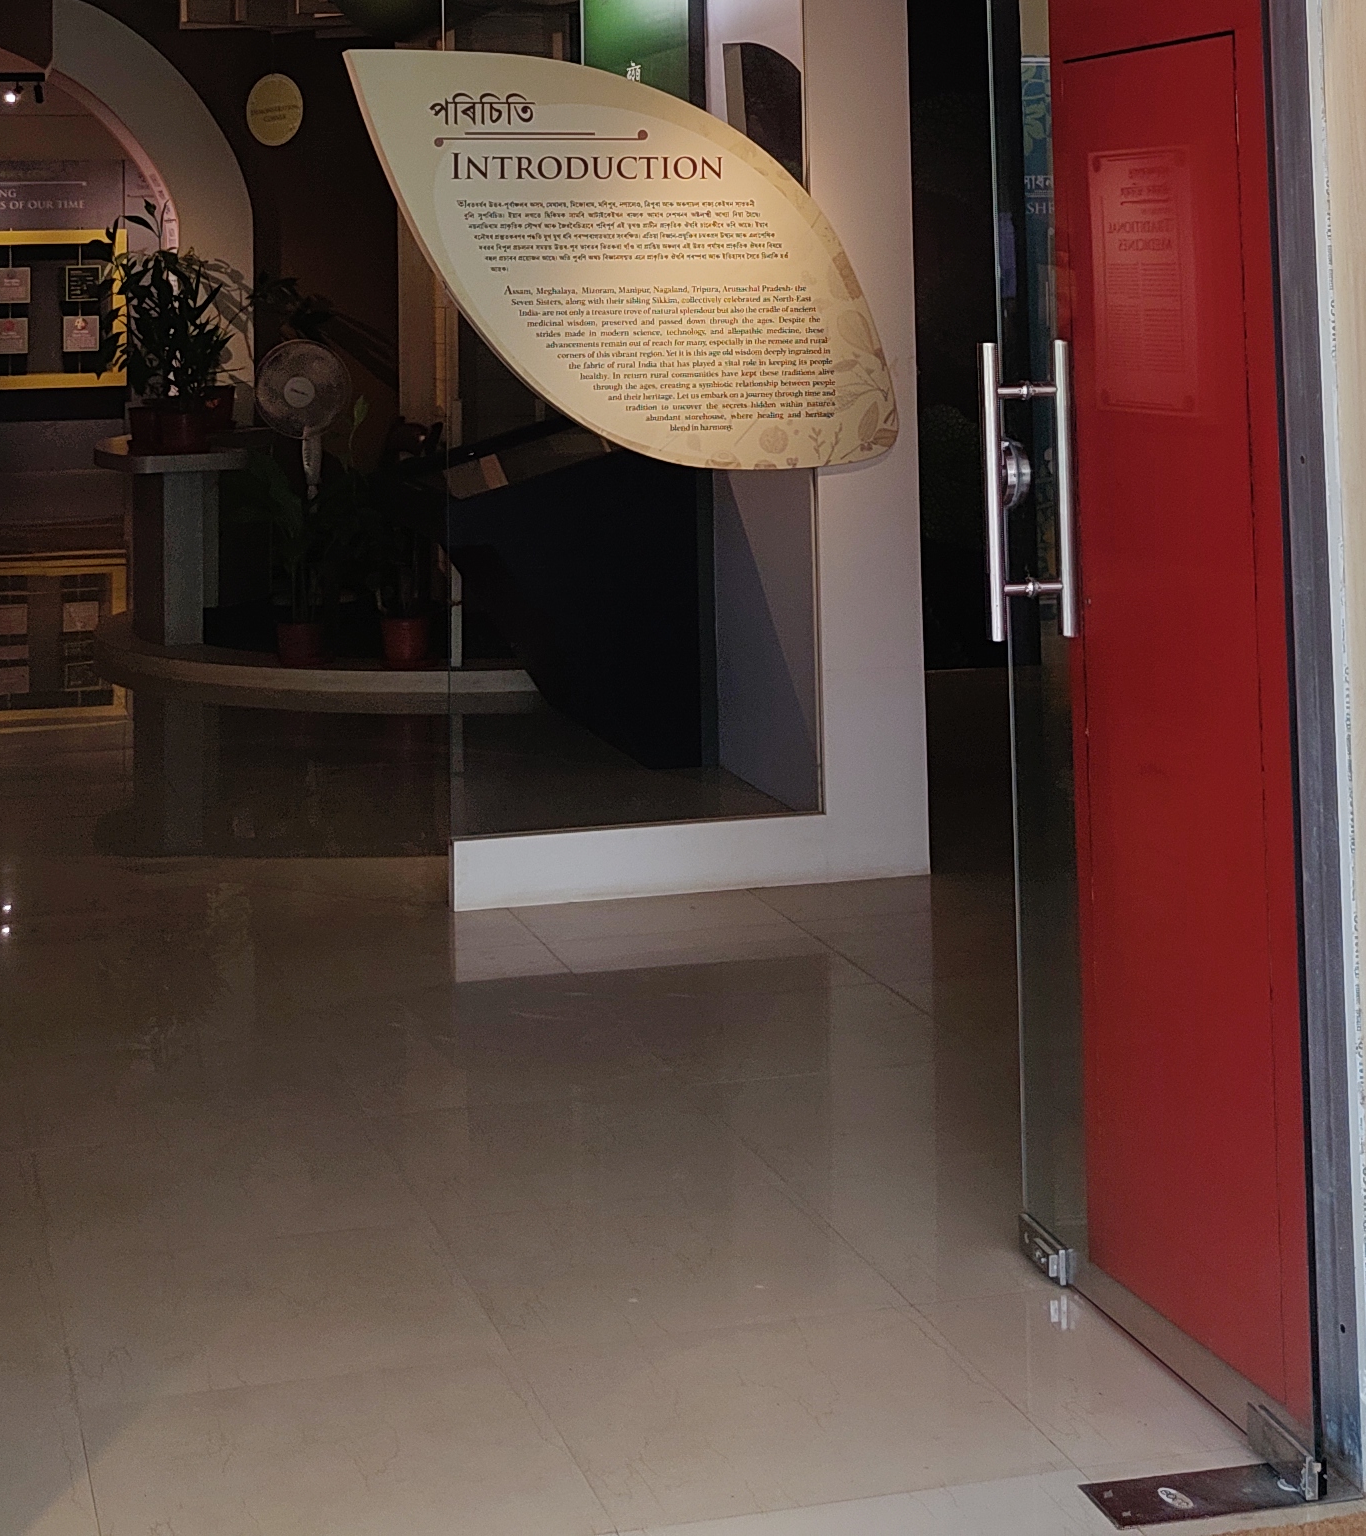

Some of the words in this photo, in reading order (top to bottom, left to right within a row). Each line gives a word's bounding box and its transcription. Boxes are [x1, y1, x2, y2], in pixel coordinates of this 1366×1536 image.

[429, 92, 536, 127] পৰিচিতি
[451, 152, 723, 181] INTRODUCTION
[9, 200, 25, 210] OF
[28, 200, 54, 210] OUR
[57, 199, 85, 209] TIME
[536, 286, 578, 297] Meghalaya,
[653, 285, 690, 295] Nagaland,
[691, 285, 721, 295] Tripura,
[511, 298, 534, 306] Seven
[535, 297, 563, 306] Sisters,
[565, 297, 586, 307] along
[587, 297, 605, 305] with
[606, 296, 624, 305] their
[625, 296, 650, 306] sibling
[652, 296, 680, 305] Sikkim,
[680, 295, 721, 306] collectively
[723, 295, 761, 303] celebrated
[568, 308, 585, 318] only
[591, 308, 623, 316] treasure
[651, 306, 679, 315] natural
[679, 306, 715, 316] splendour
[716, 306, 729, 314] but
[730, 305, 745, 314] also
[758, 305, 781, 313] cradle
[789, 304, 817, 313] ancient
[526, 319, 564, 327] medicinal
[566, 318, 600, 328] wisdom,
[601, 318, 638, 328] preserved
[640, 317, 655, 326] and
[658, 317, 682, 327] passed
[686, 316, 706, 325] down
[709, 316, 739, 326] through
[756, 318, 775, 326] ages.
[778, 315, 807, 326] Despite
[536, 329, 561, 338] strides
[564, 329, 588, 337] made
[600, 328, 629, 337] modern
[633, 328, 663, 337] science,
[709, 327, 724, 335] and
[727, 326, 763, 337] allopathic
[766, 326, 801, 335] medicine,
[805, 325, 825, 334] these
[546, 340, 600, 348] advancements
[600, 339, 628, 348] remain
[651, 338, 673, 347] reach
[674, 338, 685, 346] for
[708, 337, 744, 348] especially
[767, 337, 793, 345] remote
[794, 336, 809, 344] and
[809, 336, 828, 344] rural
[596, 350, 611, 358] this
[611, 350, 638, 358] vibrant
[639, 349, 665, 360] region.
[693, 348, 707, 357] this
[708, 350, 721, 358] age
[722, 348, 734, 356] old
[735, 347, 763, 356] wisdom
[763, 347, 787, 357] deeply
[787, 346, 822, 357] ingrained
[583, 361, 605, 369] fabric
[616, 360, 636, 369] rural
[638, 360, 657, 368] India
[659, 360, 675, 368] that
[676, 359, 690, 368] has
[692, 359, 716, 369] played
[742, 358, 757, 366] role
[768, 357, 797, 368] keeping
[809, 357, 833, 367] people
[580, 371, 611, 382] healthy.
[650, 370, 669, 379] rural
[671, 369, 719, 378] communities
[721, 369, 739, 377] have
[741, 369, 757, 379] kept
[759, 368, 779, 377] these
[781, 368, 816, 376] traditions
[818, 367, 835, 376] alive
[593, 382, 623, 393] through
[639, 384, 658, 392] ages,
[659, 381, 691, 391] creating
[735, 379, 779, 390] relationship
[780, 378, 811, 387] between
[812, 378, 835, 388] people
[608, 393, 622, 401] and
[623, 392, 641, 401] their
[642, 392, 675, 402] heritage.
[676, 391, 689, 400] Let
[700, 390, 728, 399] embark
[745, 391, 773, 400] journey
[774, 389, 803, 400] through
[804, 389, 821, 397] time
[821, 388, 835, 397] and
[625, 403, 658, 411] tradition
[779, 399, 803, 408] within
[645, 413, 681, 422] abundant
[730, 411, 753, 420] where
[757, 410, 784, 421] healing
[787, 410, 802, 418] and
[804, 409, 835, 420] heritage
[670, 423, 691, 432] blend
